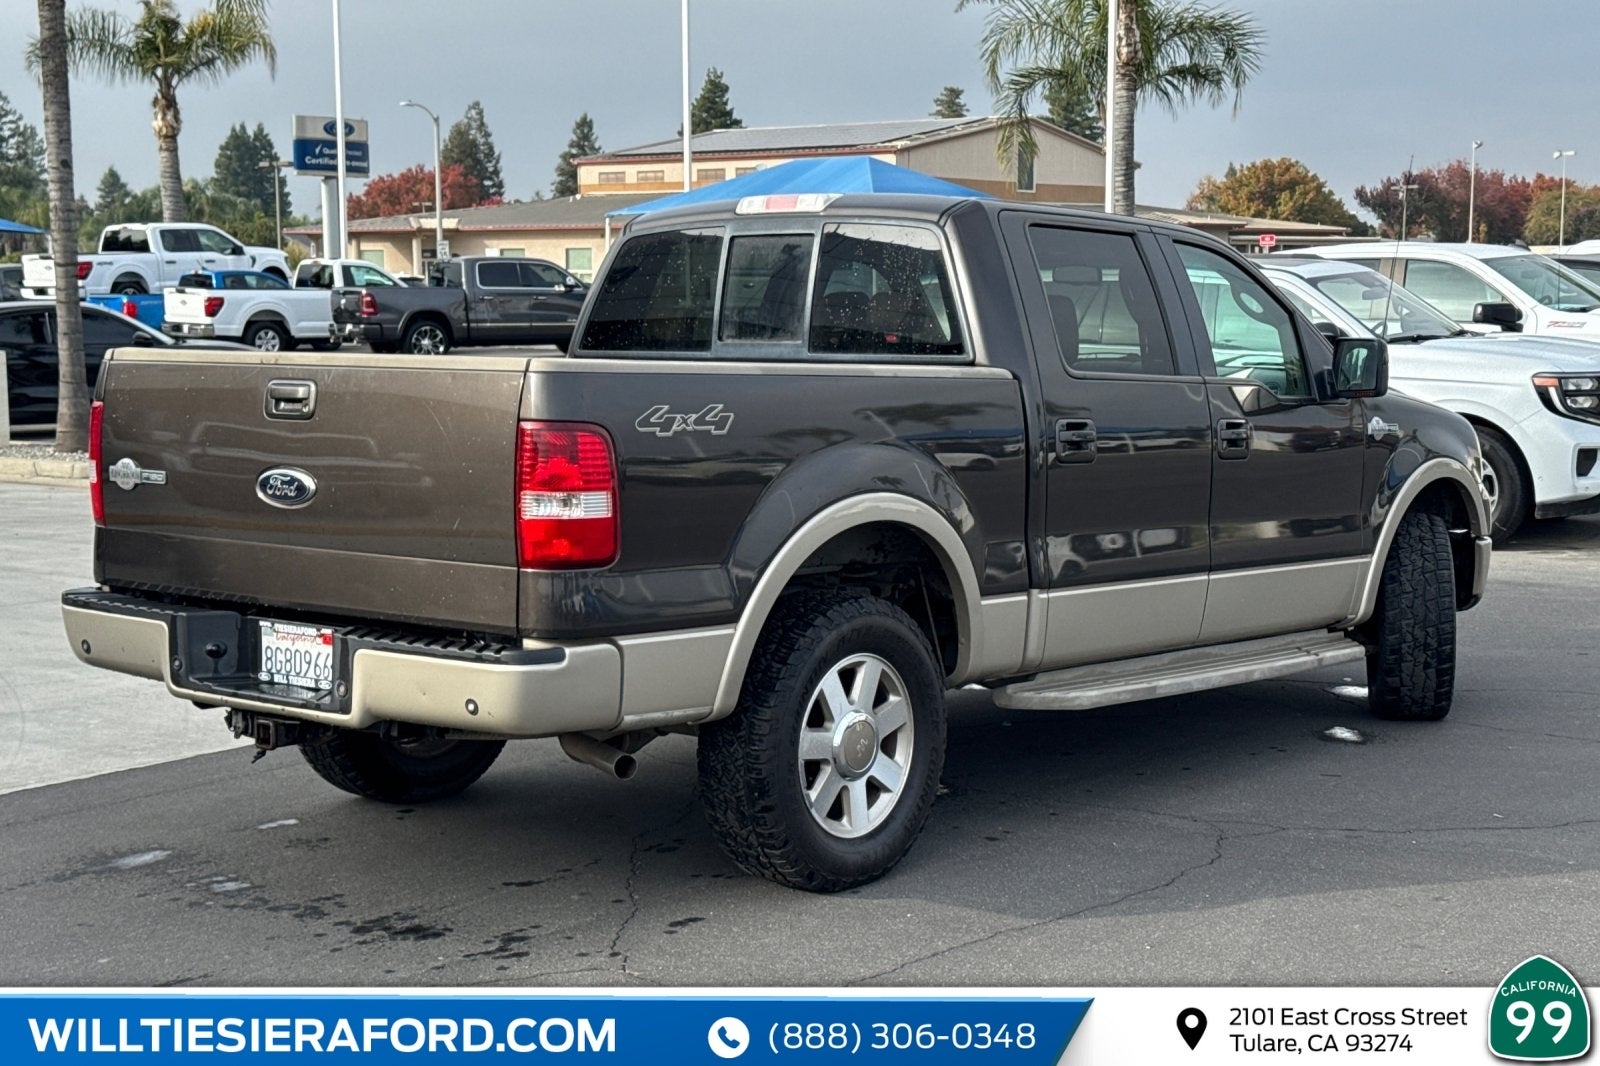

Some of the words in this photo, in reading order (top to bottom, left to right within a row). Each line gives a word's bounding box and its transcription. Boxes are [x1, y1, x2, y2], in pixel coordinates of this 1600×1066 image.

[635, 404, 734, 437] 4x4
[267, 474, 298, 497] Ford
[264, 645, 331, 680] 8G80966
